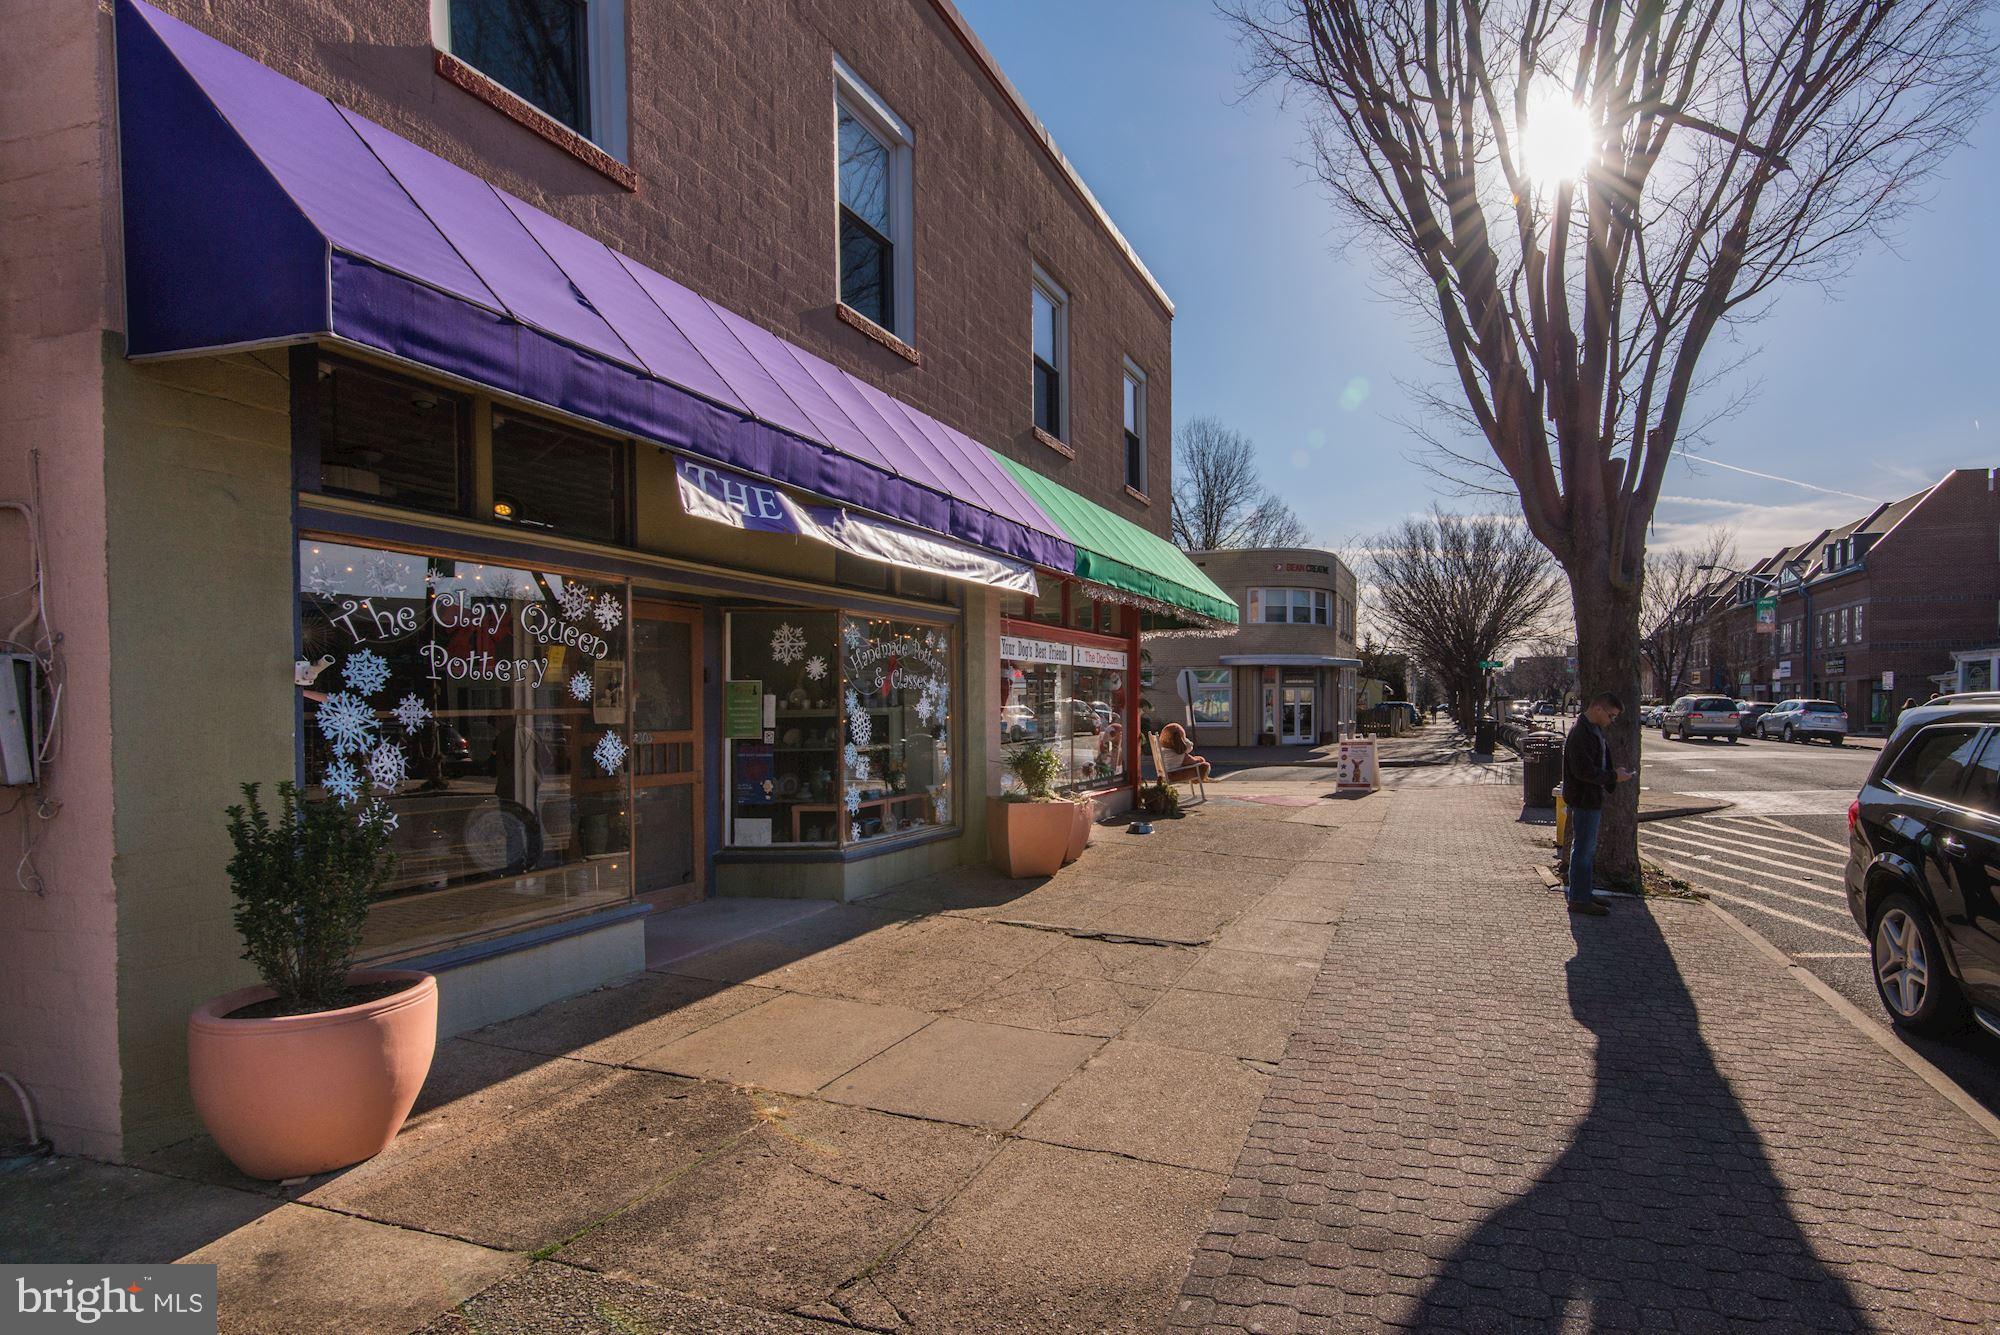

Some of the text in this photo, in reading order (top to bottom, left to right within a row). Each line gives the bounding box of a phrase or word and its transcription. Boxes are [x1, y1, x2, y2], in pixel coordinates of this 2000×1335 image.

[685, 462, 782, 520] THE
[330, 589, 608, 659] The Clay Queen
[420, 640, 548, 689] Pottery
[850, 635, 947, 680] Handmade Pottery
[1001, 638, 1067, 661] Your Dog's Best Friends
[1085, 651, 1096, 663] The
[874, 667, 929, 690] & Classes
